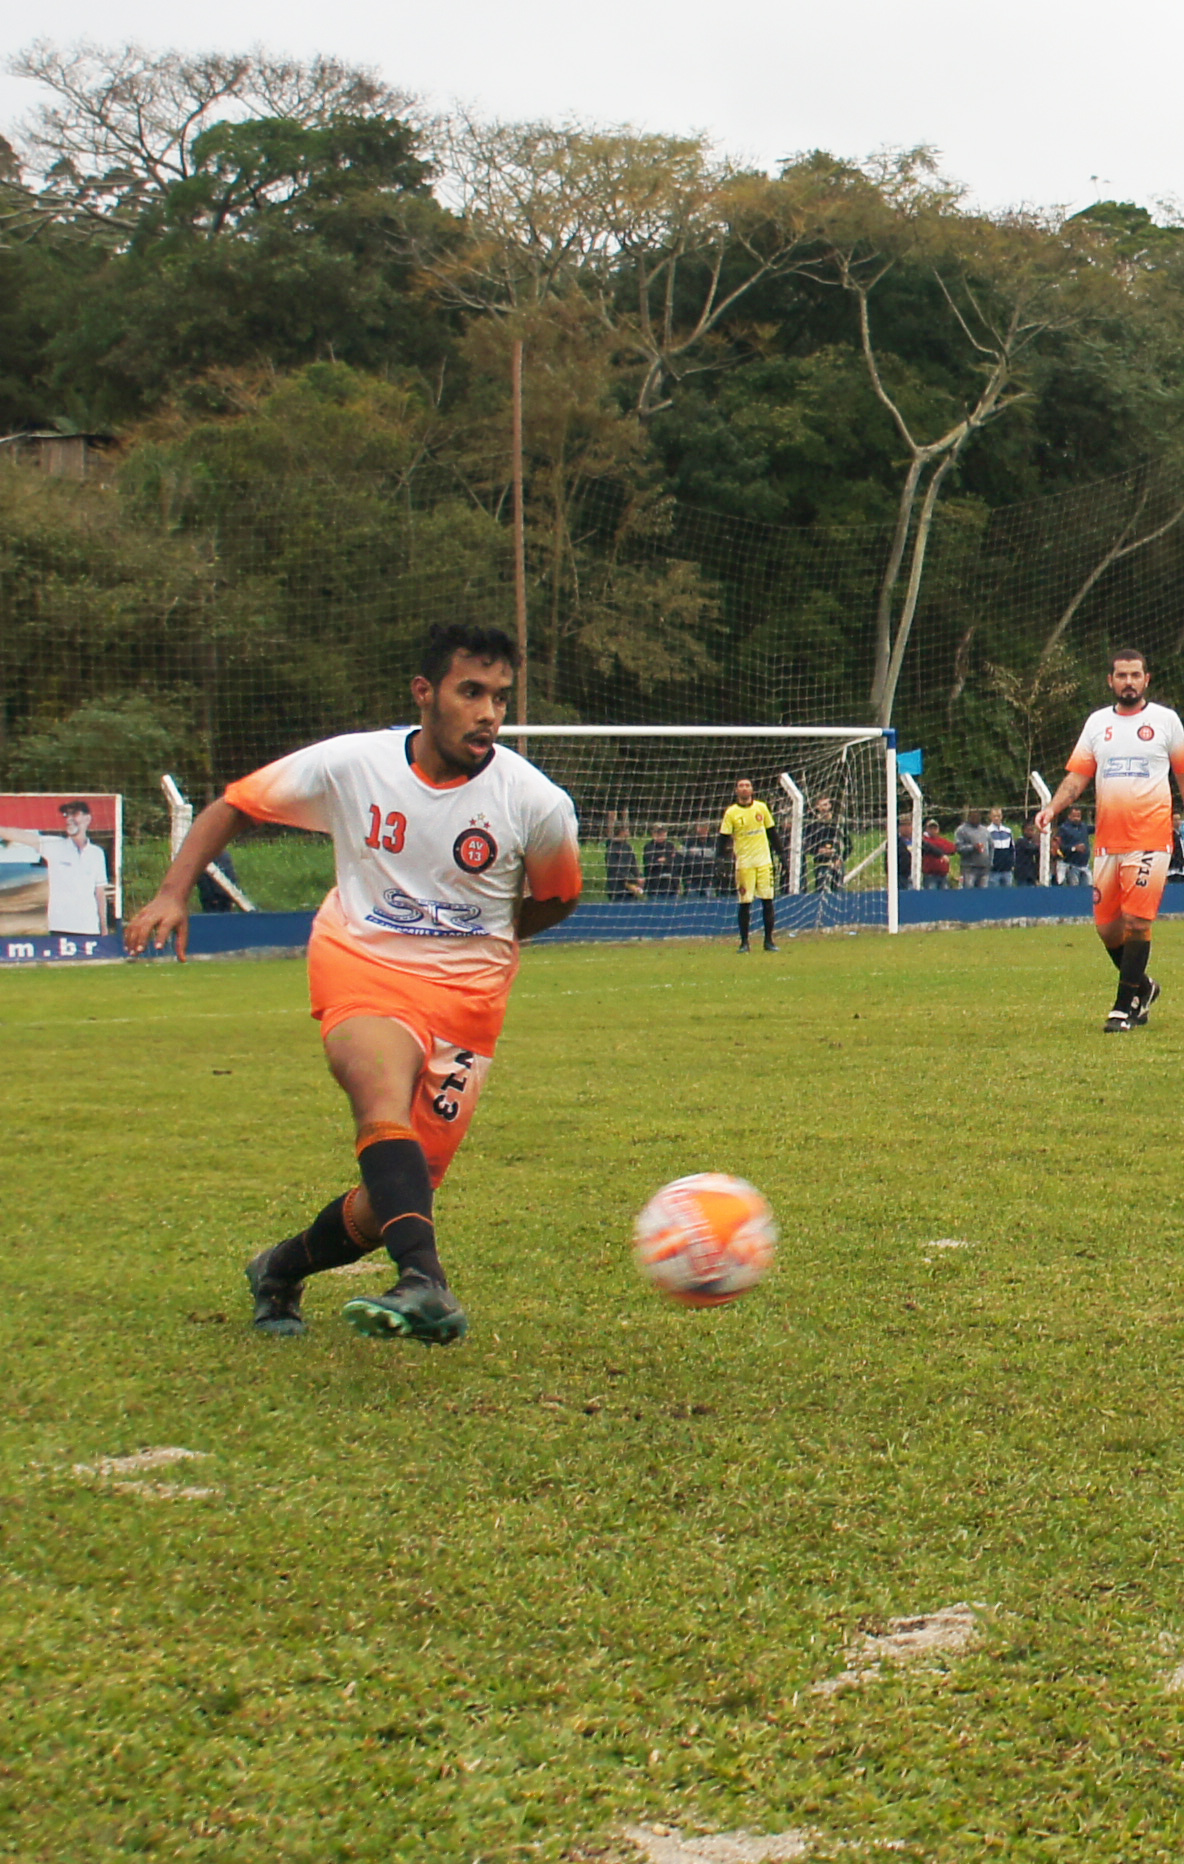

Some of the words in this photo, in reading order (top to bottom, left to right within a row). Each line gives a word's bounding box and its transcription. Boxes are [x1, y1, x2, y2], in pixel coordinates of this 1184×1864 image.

[1104, 726, 1113, 742] 5
[364, 803, 407, 854] 13
[468, 840, 485, 850] AV
[468, 851, 482, 861] 13
[433, 1046, 475, 1121] V13
